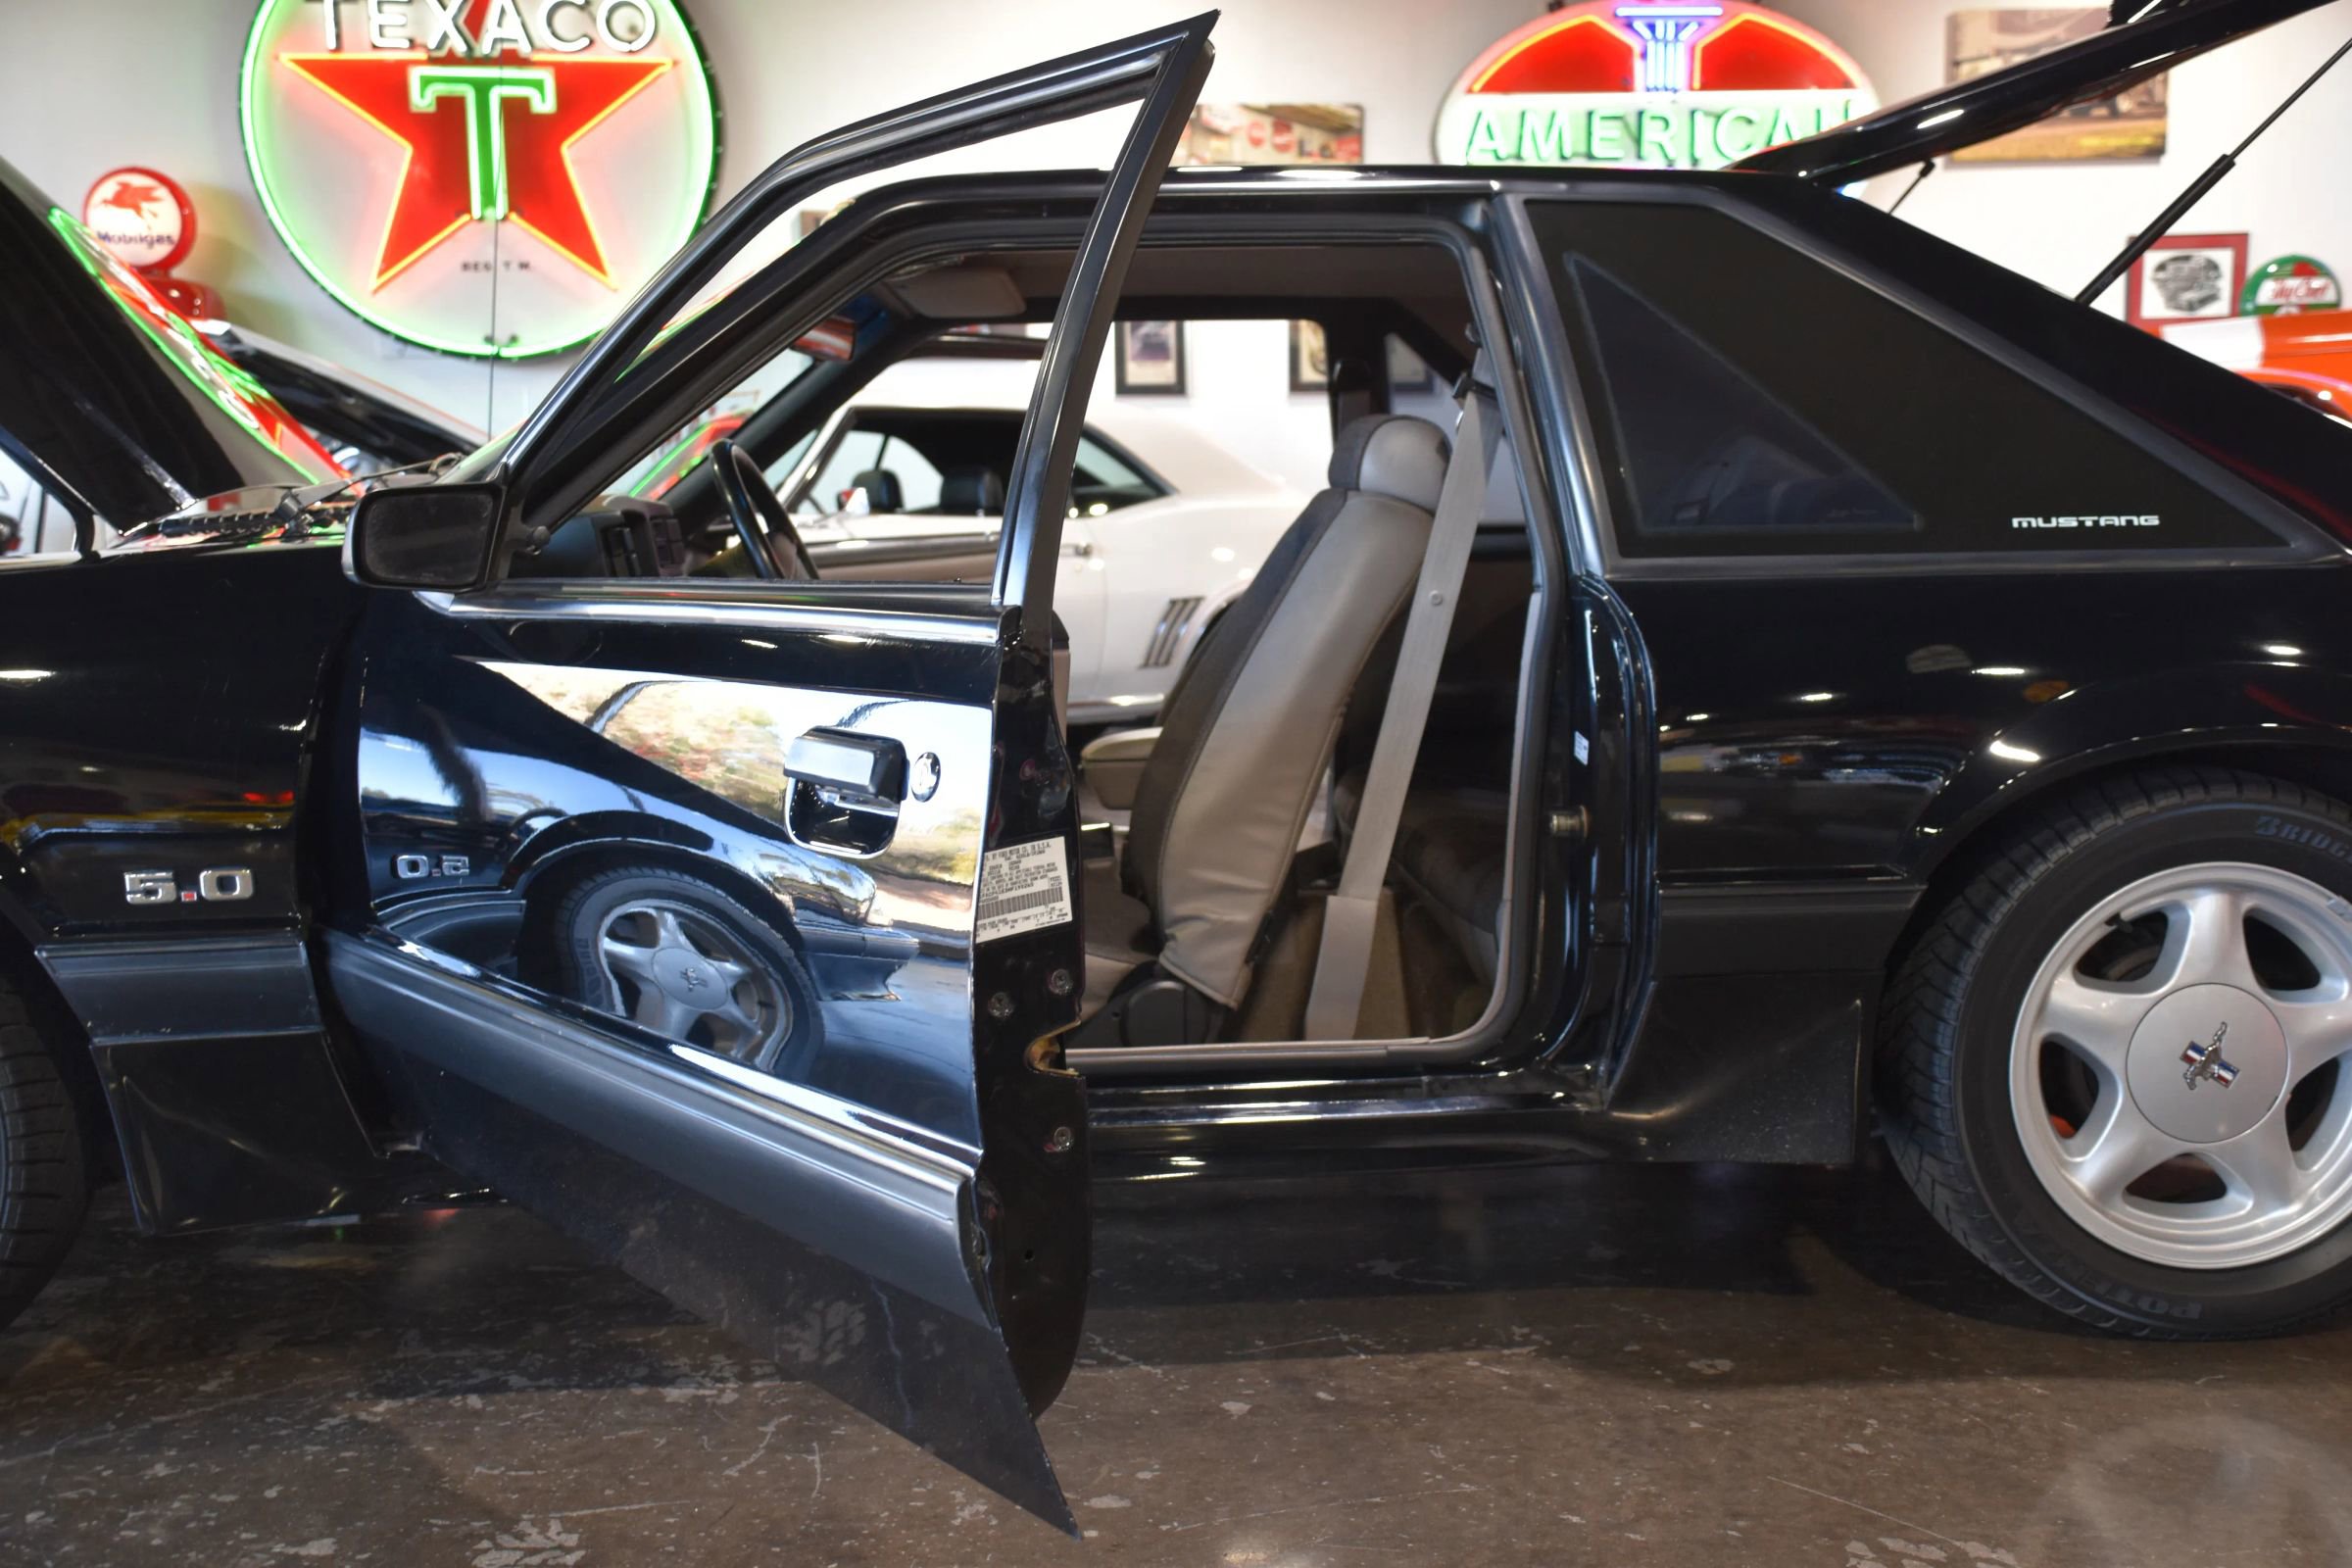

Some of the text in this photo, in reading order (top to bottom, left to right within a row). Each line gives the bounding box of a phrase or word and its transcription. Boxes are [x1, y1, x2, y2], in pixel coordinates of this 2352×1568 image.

[308, 0, 657, 53] TEXACO
[408, 66, 557, 220] T
[2012, 514, 2160, 528] MUSTANG
[123, 866, 254, 904] 5.0
